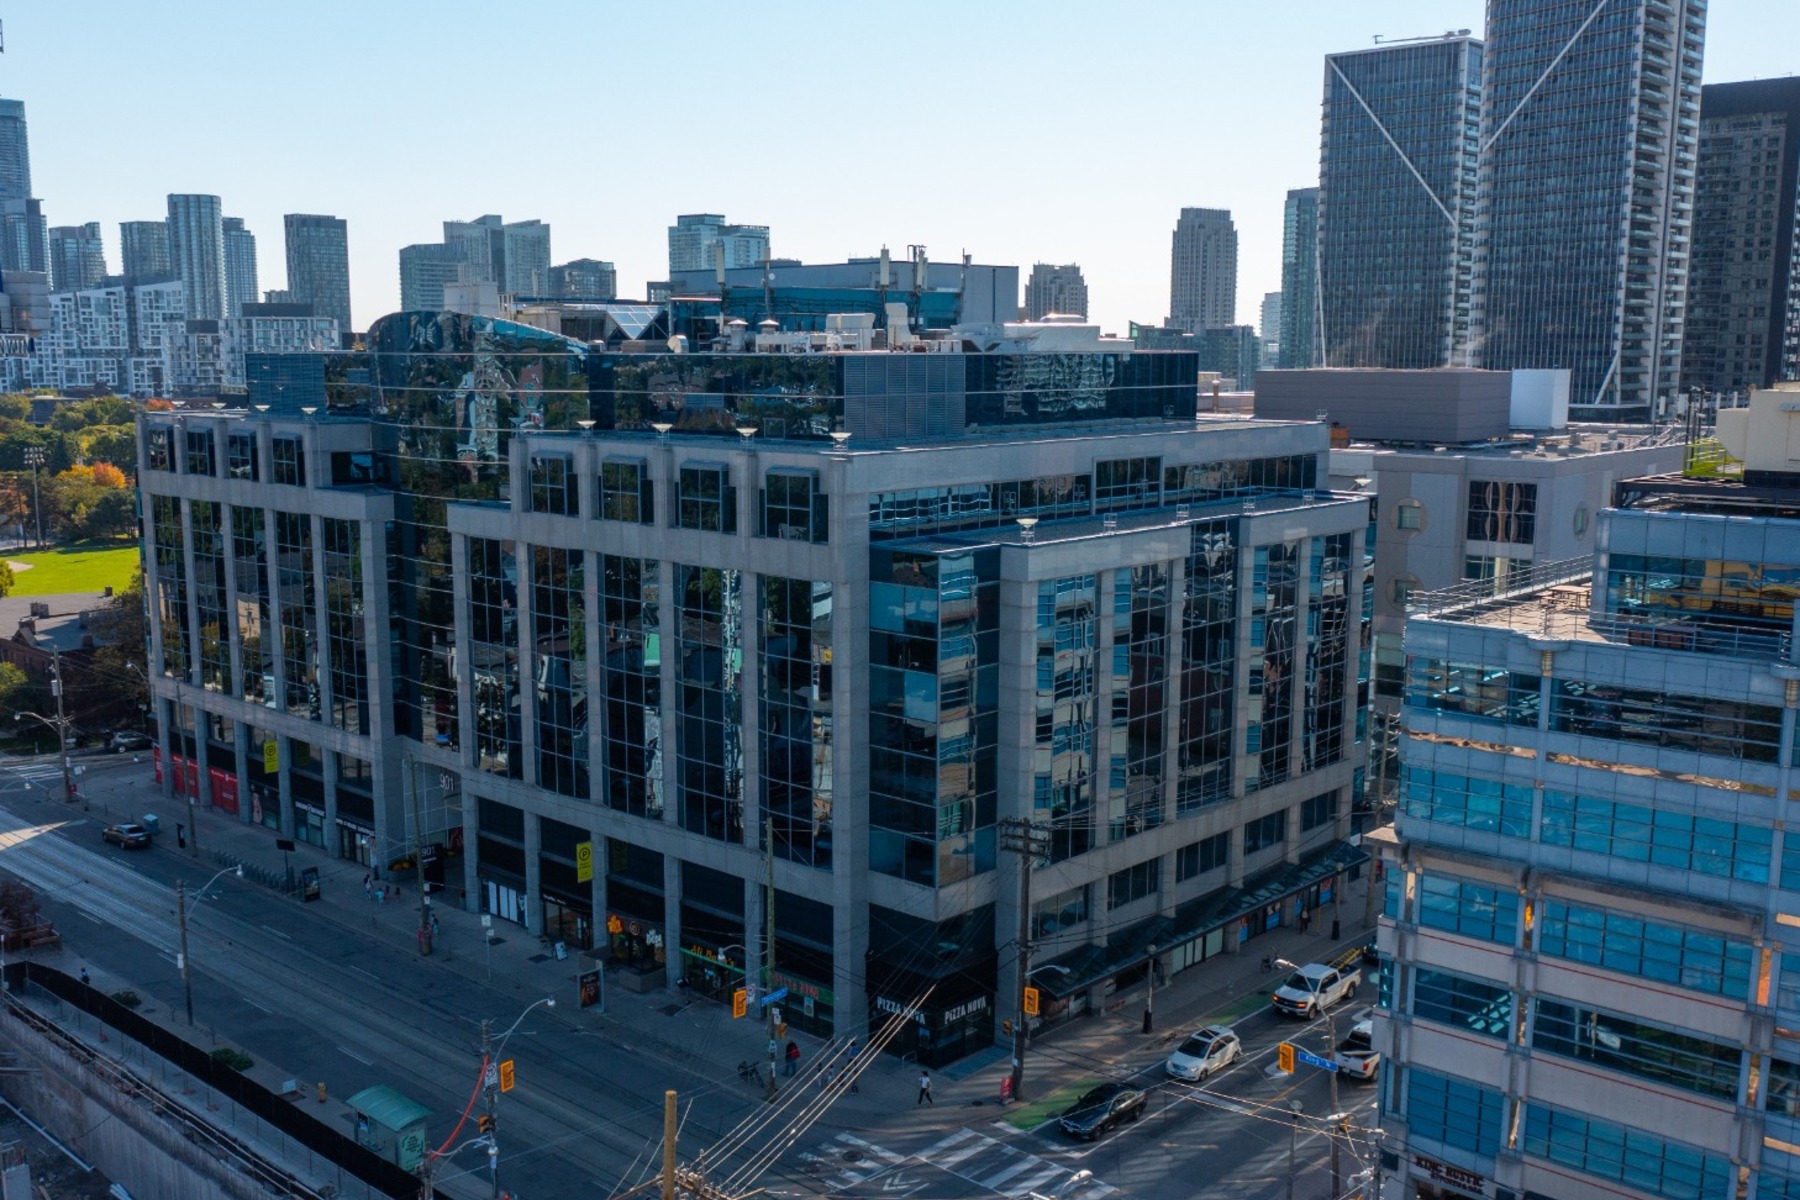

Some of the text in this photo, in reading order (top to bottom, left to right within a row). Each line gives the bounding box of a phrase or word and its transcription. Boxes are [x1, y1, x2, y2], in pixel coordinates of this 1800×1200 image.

[440, 774, 454, 791] 901
[421, 846, 435, 857] 901
[690, 944, 734, 966] Ali Ba's
[877, 996, 901, 1015] PIZZA
[944, 996, 987, 1024] PIZZA NOVA
[1415, 1156, 1485, 1187] KING RUSTIC
